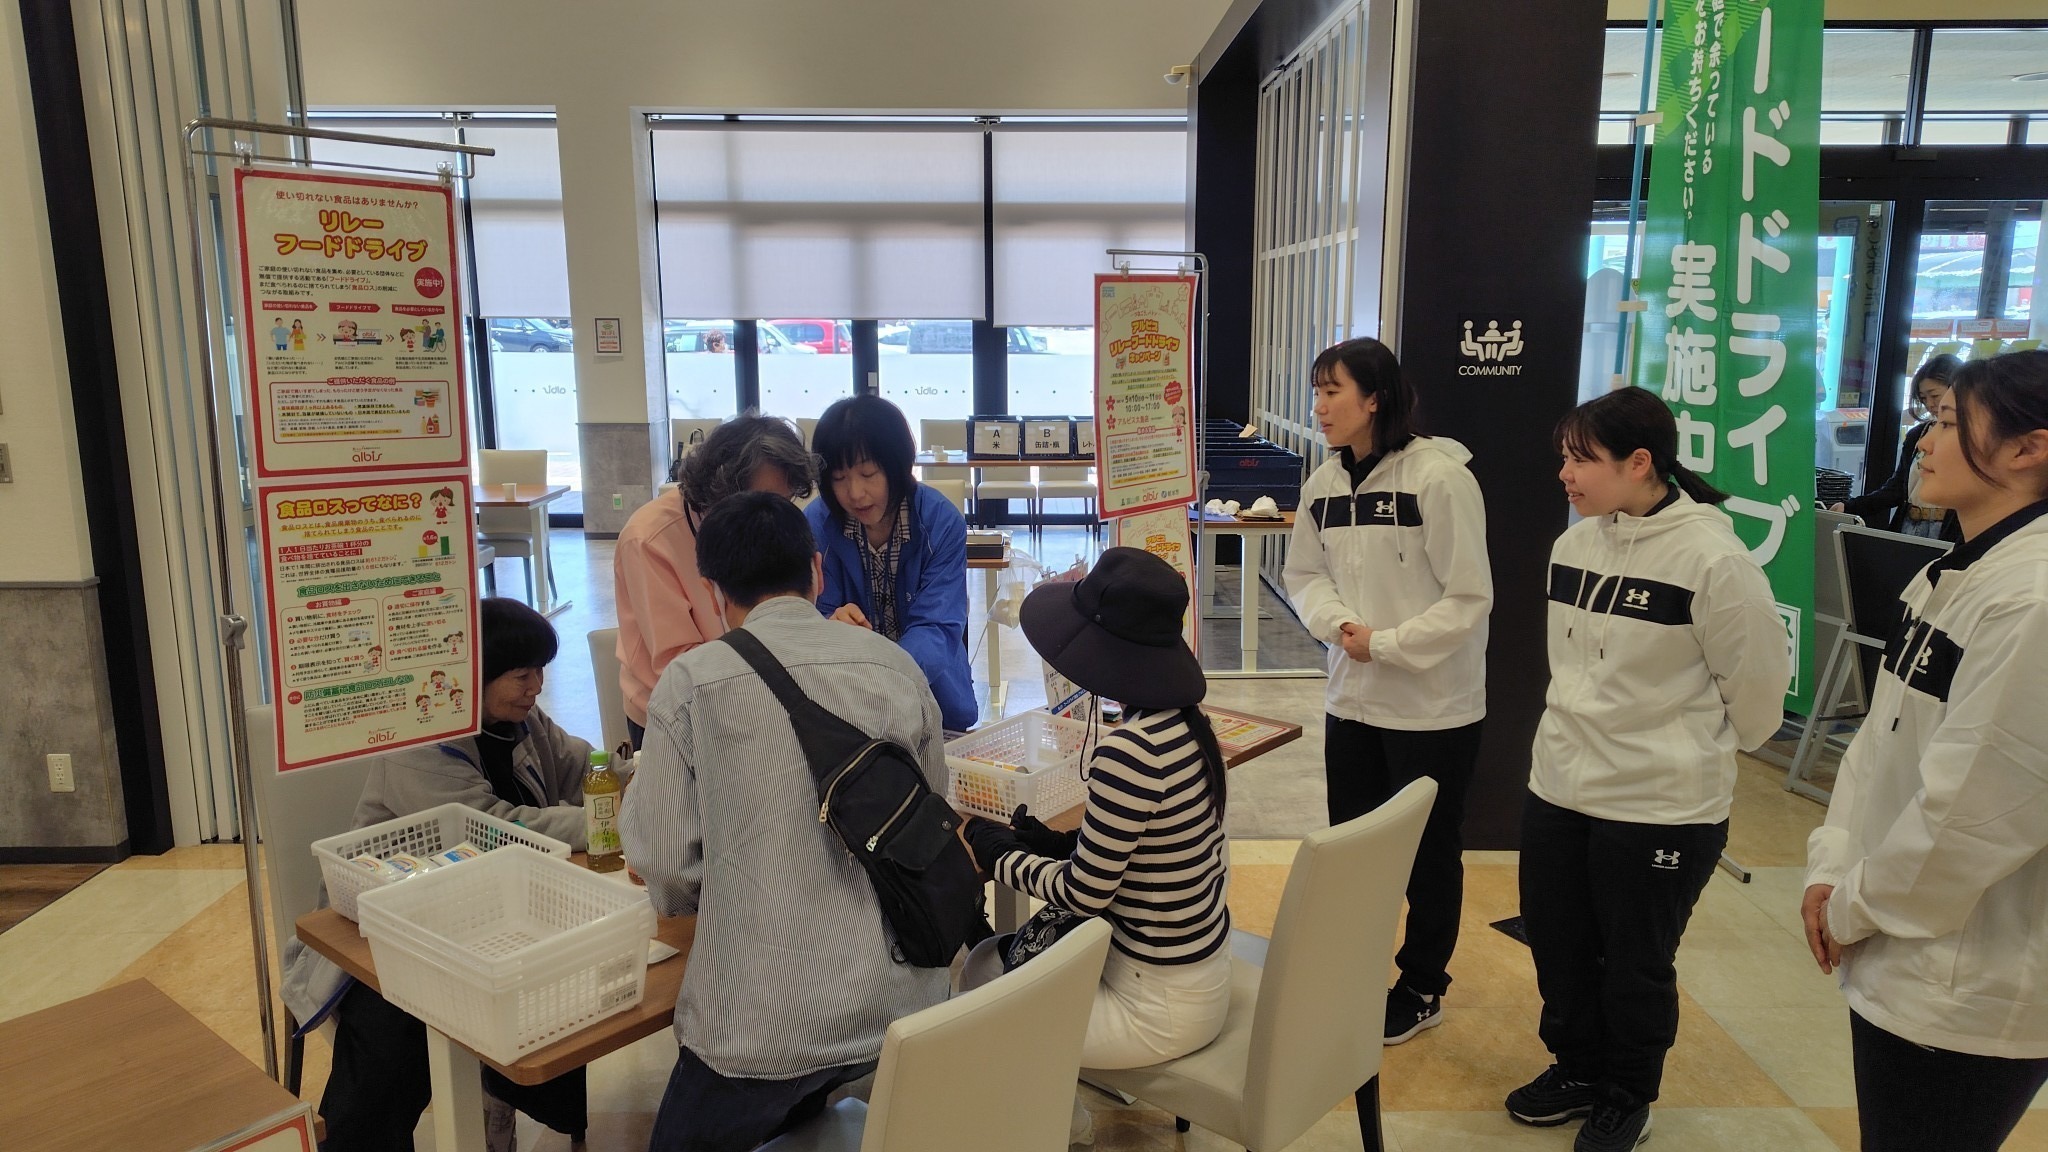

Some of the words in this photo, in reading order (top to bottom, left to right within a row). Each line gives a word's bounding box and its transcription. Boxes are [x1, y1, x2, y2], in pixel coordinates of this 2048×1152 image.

[275, 190, 419, 210] 使い切れない食品はありませんか？
[318, 209, 384, 233] リレー
[274, 233, 428, 262] フードドライブ
[416, 278, 443, 288] 実施中!
[1458, 365, 1523, 376] COMMUNITY
[993, 429, 1000, 437] A
[1044, 429, 1051, 437] B
[992, 441, 1000, 449] 米
[352, 450, 382, 463] albis
[1143, 490, 1159, 502] albis
[277, 492, 423, 519] 食品ロスってなに？
[280, 515, 422, 532] 食品ロスとは、食品廃棄物のうち、食べられるのに
[304, 525, 404, 539] 捨てられてしまう食品のことです。
[367, 731, 398, 745] albis
